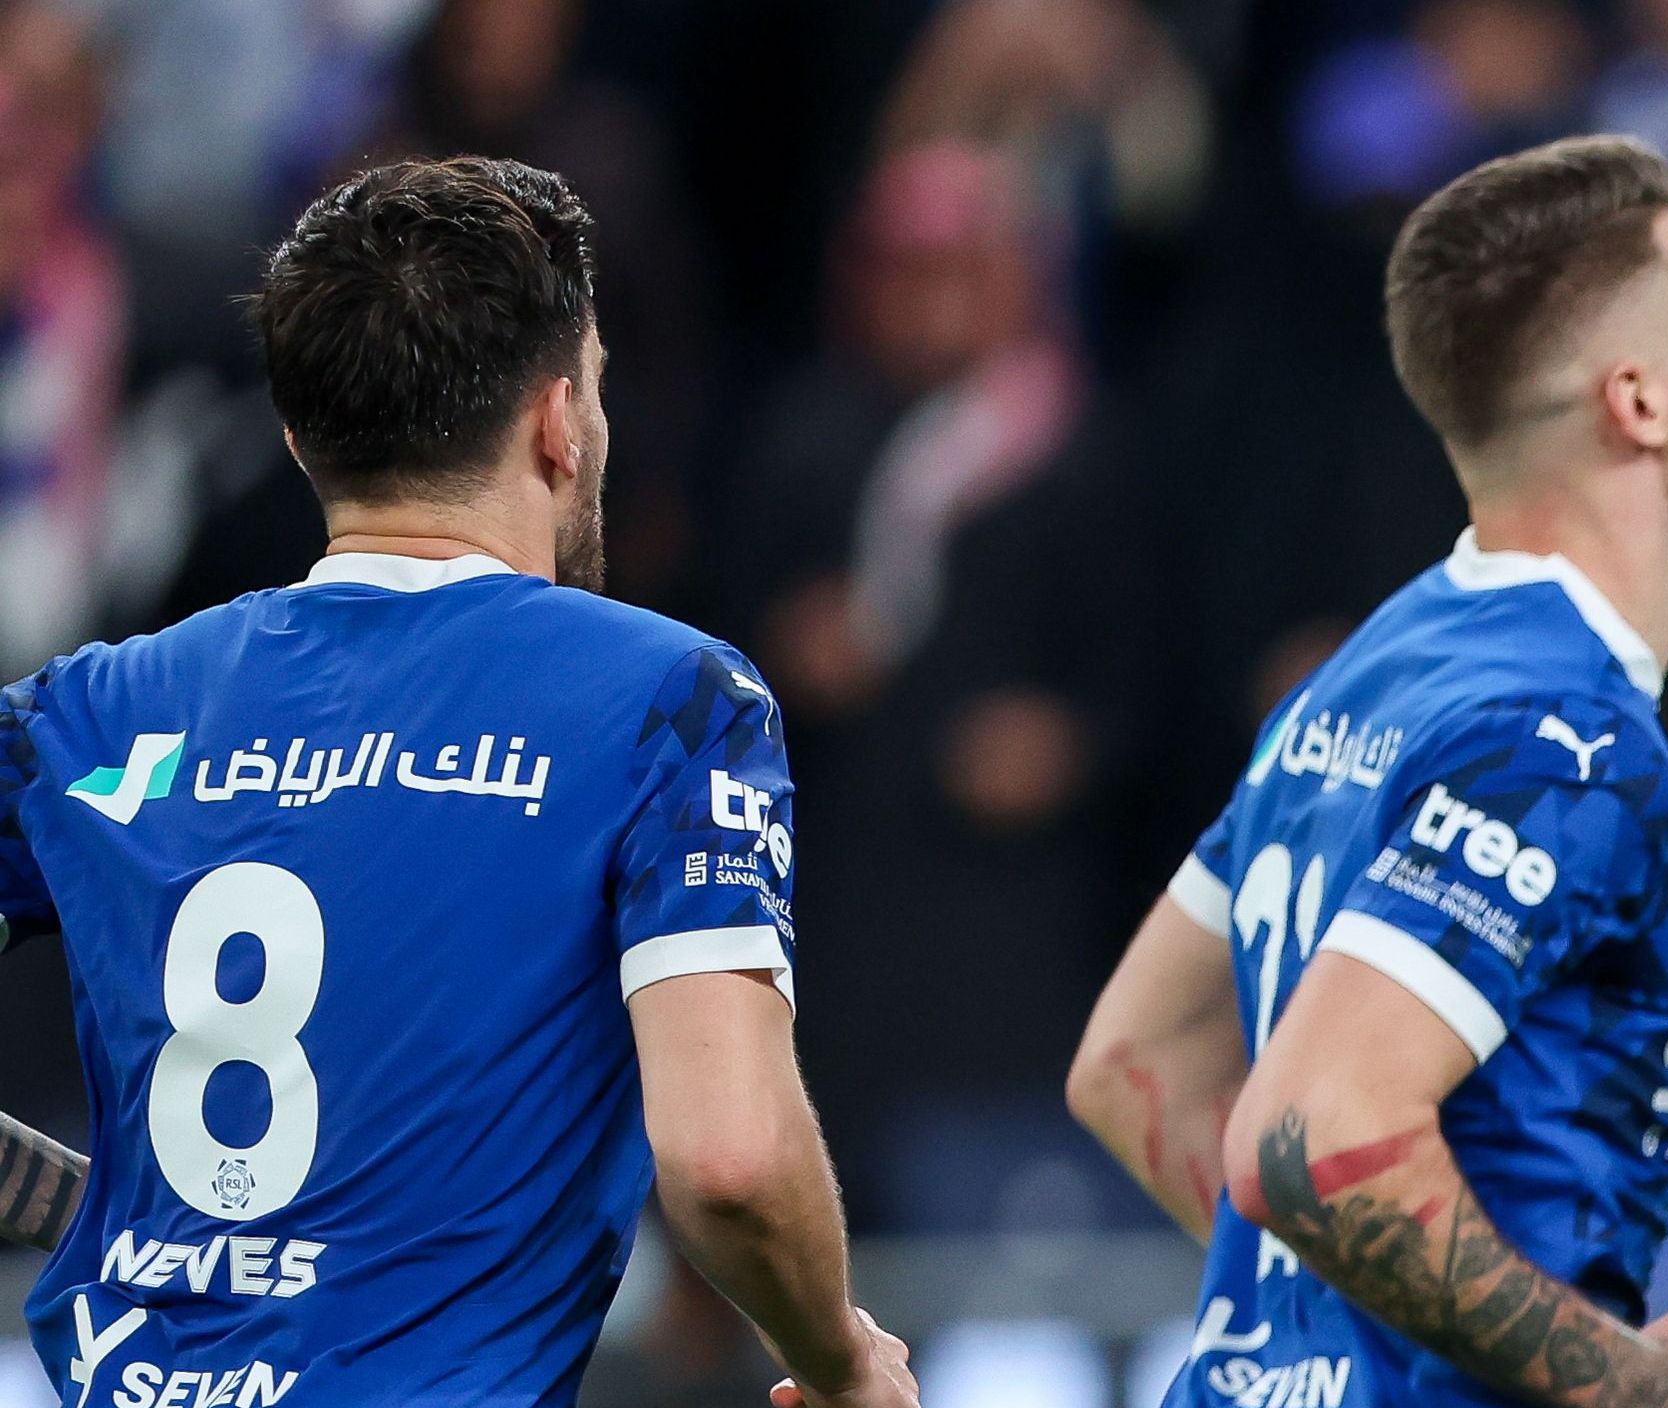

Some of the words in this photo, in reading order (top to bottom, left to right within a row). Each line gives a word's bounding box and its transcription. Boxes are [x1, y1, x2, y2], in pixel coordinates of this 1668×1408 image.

[193, 732, 395, 807] الرياض
[397, 734, 551, 816] بنك
[709, 768, 794, 880] tre
[1410, 782, 1558, 908] tree
[148, 862, 325, 1221] 8
[225, 1178, 243, 1191] RSL
[100, 1229, 328, 1298] NEVES
